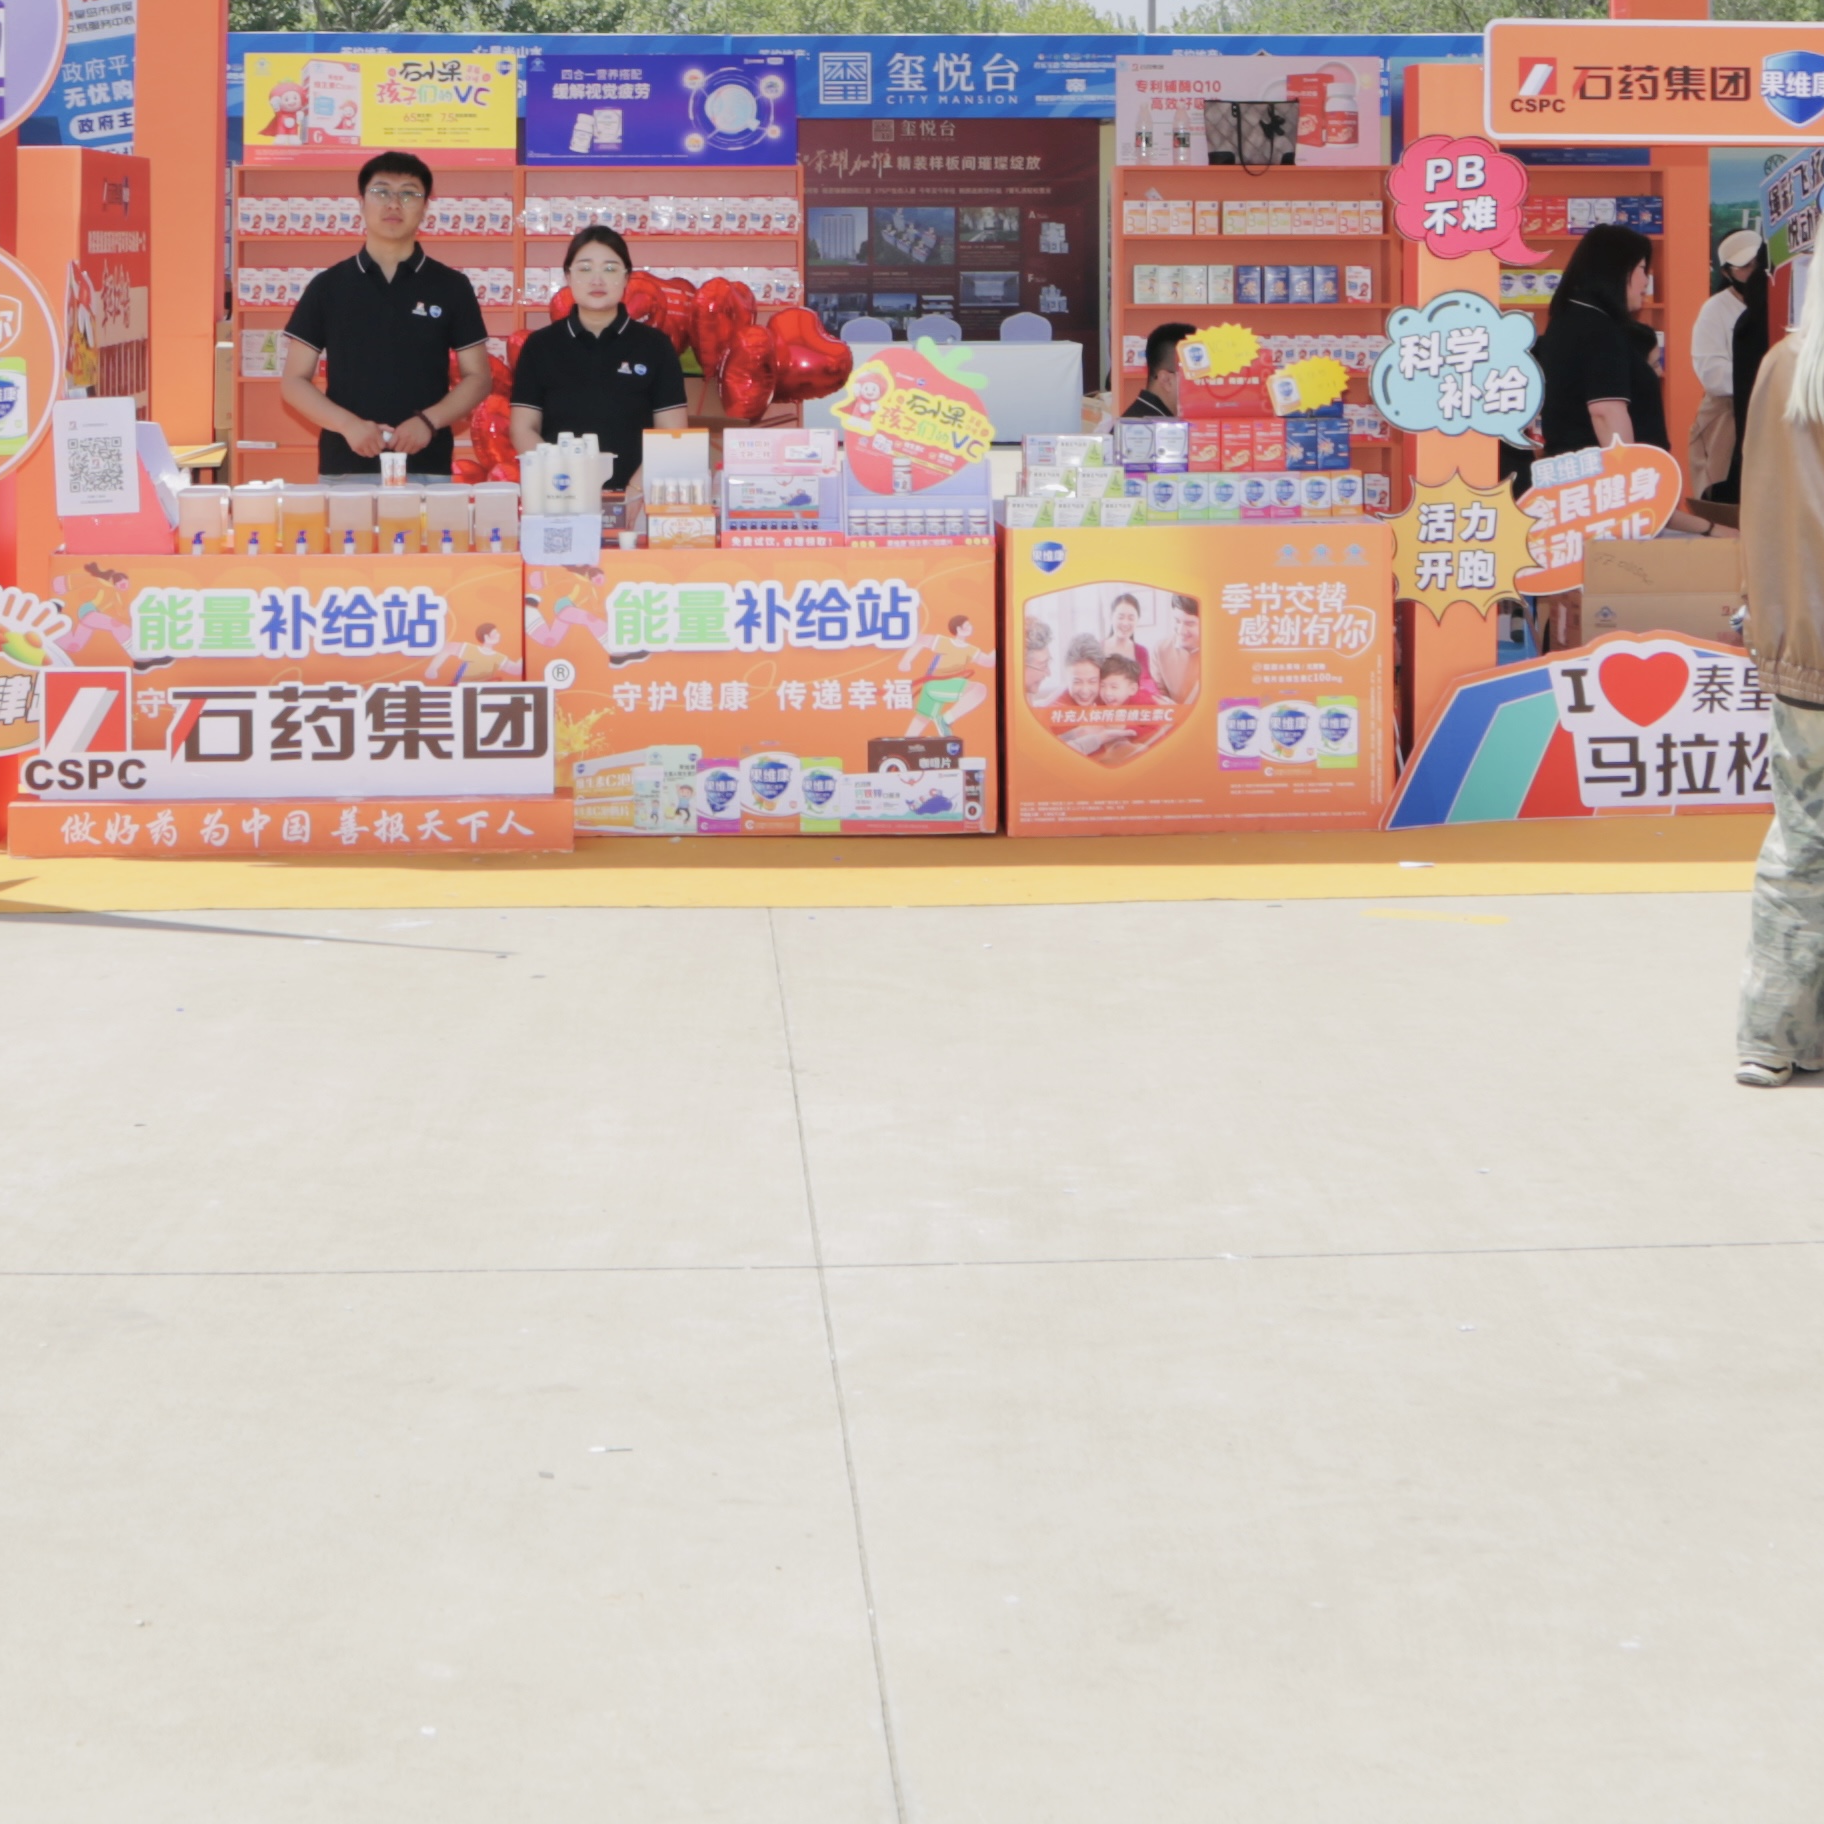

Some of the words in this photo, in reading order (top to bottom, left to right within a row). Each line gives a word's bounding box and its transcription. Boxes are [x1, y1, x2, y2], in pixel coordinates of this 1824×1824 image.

[62, 54, 134, 83] 政府平
[399, 60, 462, 82] 石小果
[886, 52, 1020, 92] 玺悦台
[1573, 65, 1751, 102] 石药集团
[377, 79, 490, 106] 孩子们的VC
[552, 83, 650, 100] 缓解视觉疲劳
[886, 95, 917, 105] CITY
[926, 95, 1019, 105] MANSION
[1135, 79, 1222, 94] 专利辅酶Q10
[1151, 96, 1221, 110] 高效好吸
[1511, 98, 1565, 113] CSPC
[900, 120, 956, 138] 玺悦台
[897, 156, 1041, 171] 精装样板间璀璨绽放
[1425, 154, 1486, 191] PB
[1423, 196, 1497, 236] 不难
[1398, 326, 1490, 379] 科学
[1438, 366, 1530, 420] 补给
[1535, 452, 1602, 484] 果维康
[1417, 502, 1497, 543] 活力
[1032, 546, 1065, 563] 果维康
[1416, 550, 1496, 590] 开跑
[1221, 582, 1346, 615] 季节交替
[138, 593, 440, 653] 能量补给站
[613, 584, 914, 648] 能量补给站
[1238, 613, 1368, 651] 感谢有你
[612, 680, 749, 713] 守护健康
[776, 678, 914, 712] 传递幸福
[1561, 668, 1595, 713] I
[172, 685, 549, 763] 石药集团
[1051, 708, 1175, 725] 补充人体所需维生素C
[1269, 715, 1310, 731] 果维康
[24, 758, 147, 791] CSPC
[749, 767, 791, 784] 果维康
[62, 811, 178, 847] 做好药
[199, 809, 312, 847] 为中国
[330, 808, 534, 846] 善报天下人
